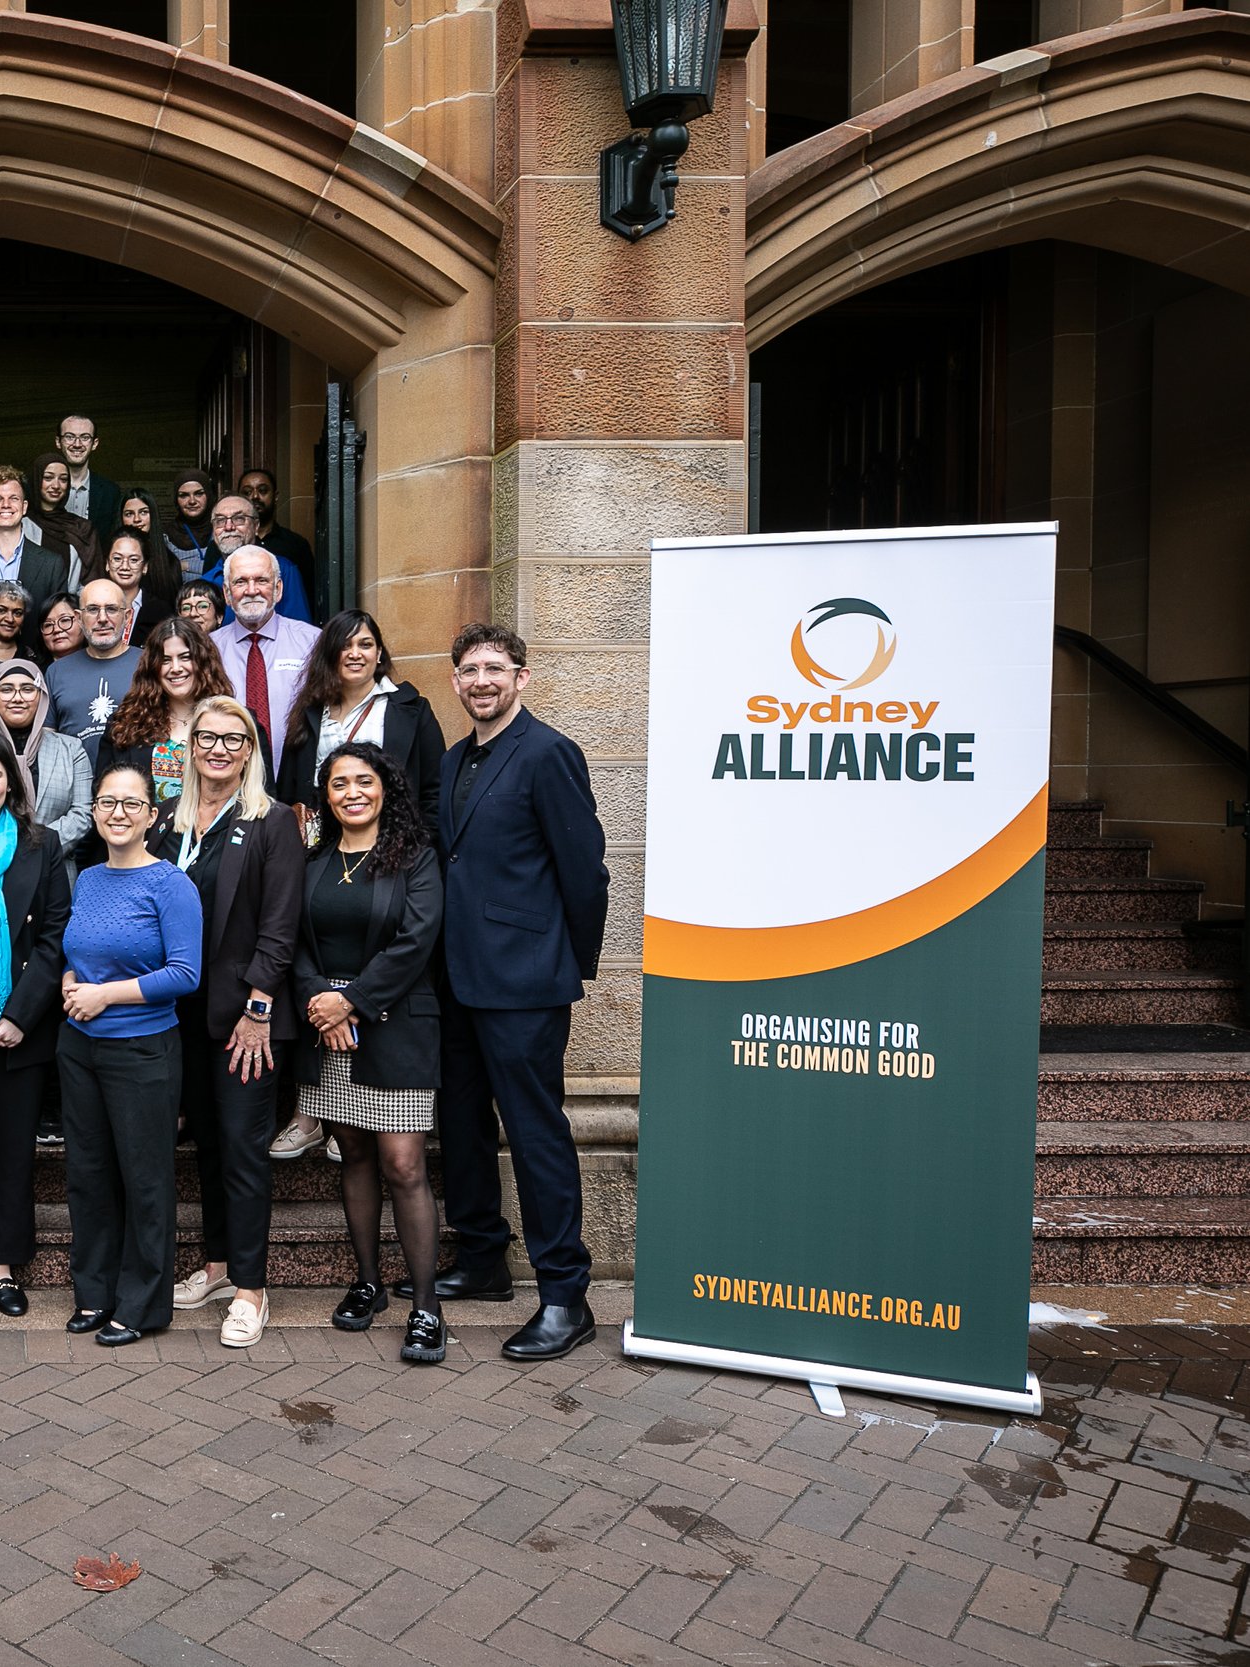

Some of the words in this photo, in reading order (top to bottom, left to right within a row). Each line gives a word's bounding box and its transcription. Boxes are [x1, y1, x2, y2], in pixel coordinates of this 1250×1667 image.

[746, 694, 939, 730] Sydney
[712, 732, 975, 783] ALLIANCE
[741, 1013, 871, 1046] ORGANISING
[879, 1021, 919, 1050] FOR
[730, 1040, 770, 1068] THE
[776, 1043, 870, 1075] COMMON
[877, 1050, 936, 1079] GOOD
[692, 1273, 962, 1332] SYDNEYALLIANCE.ORG.AU
